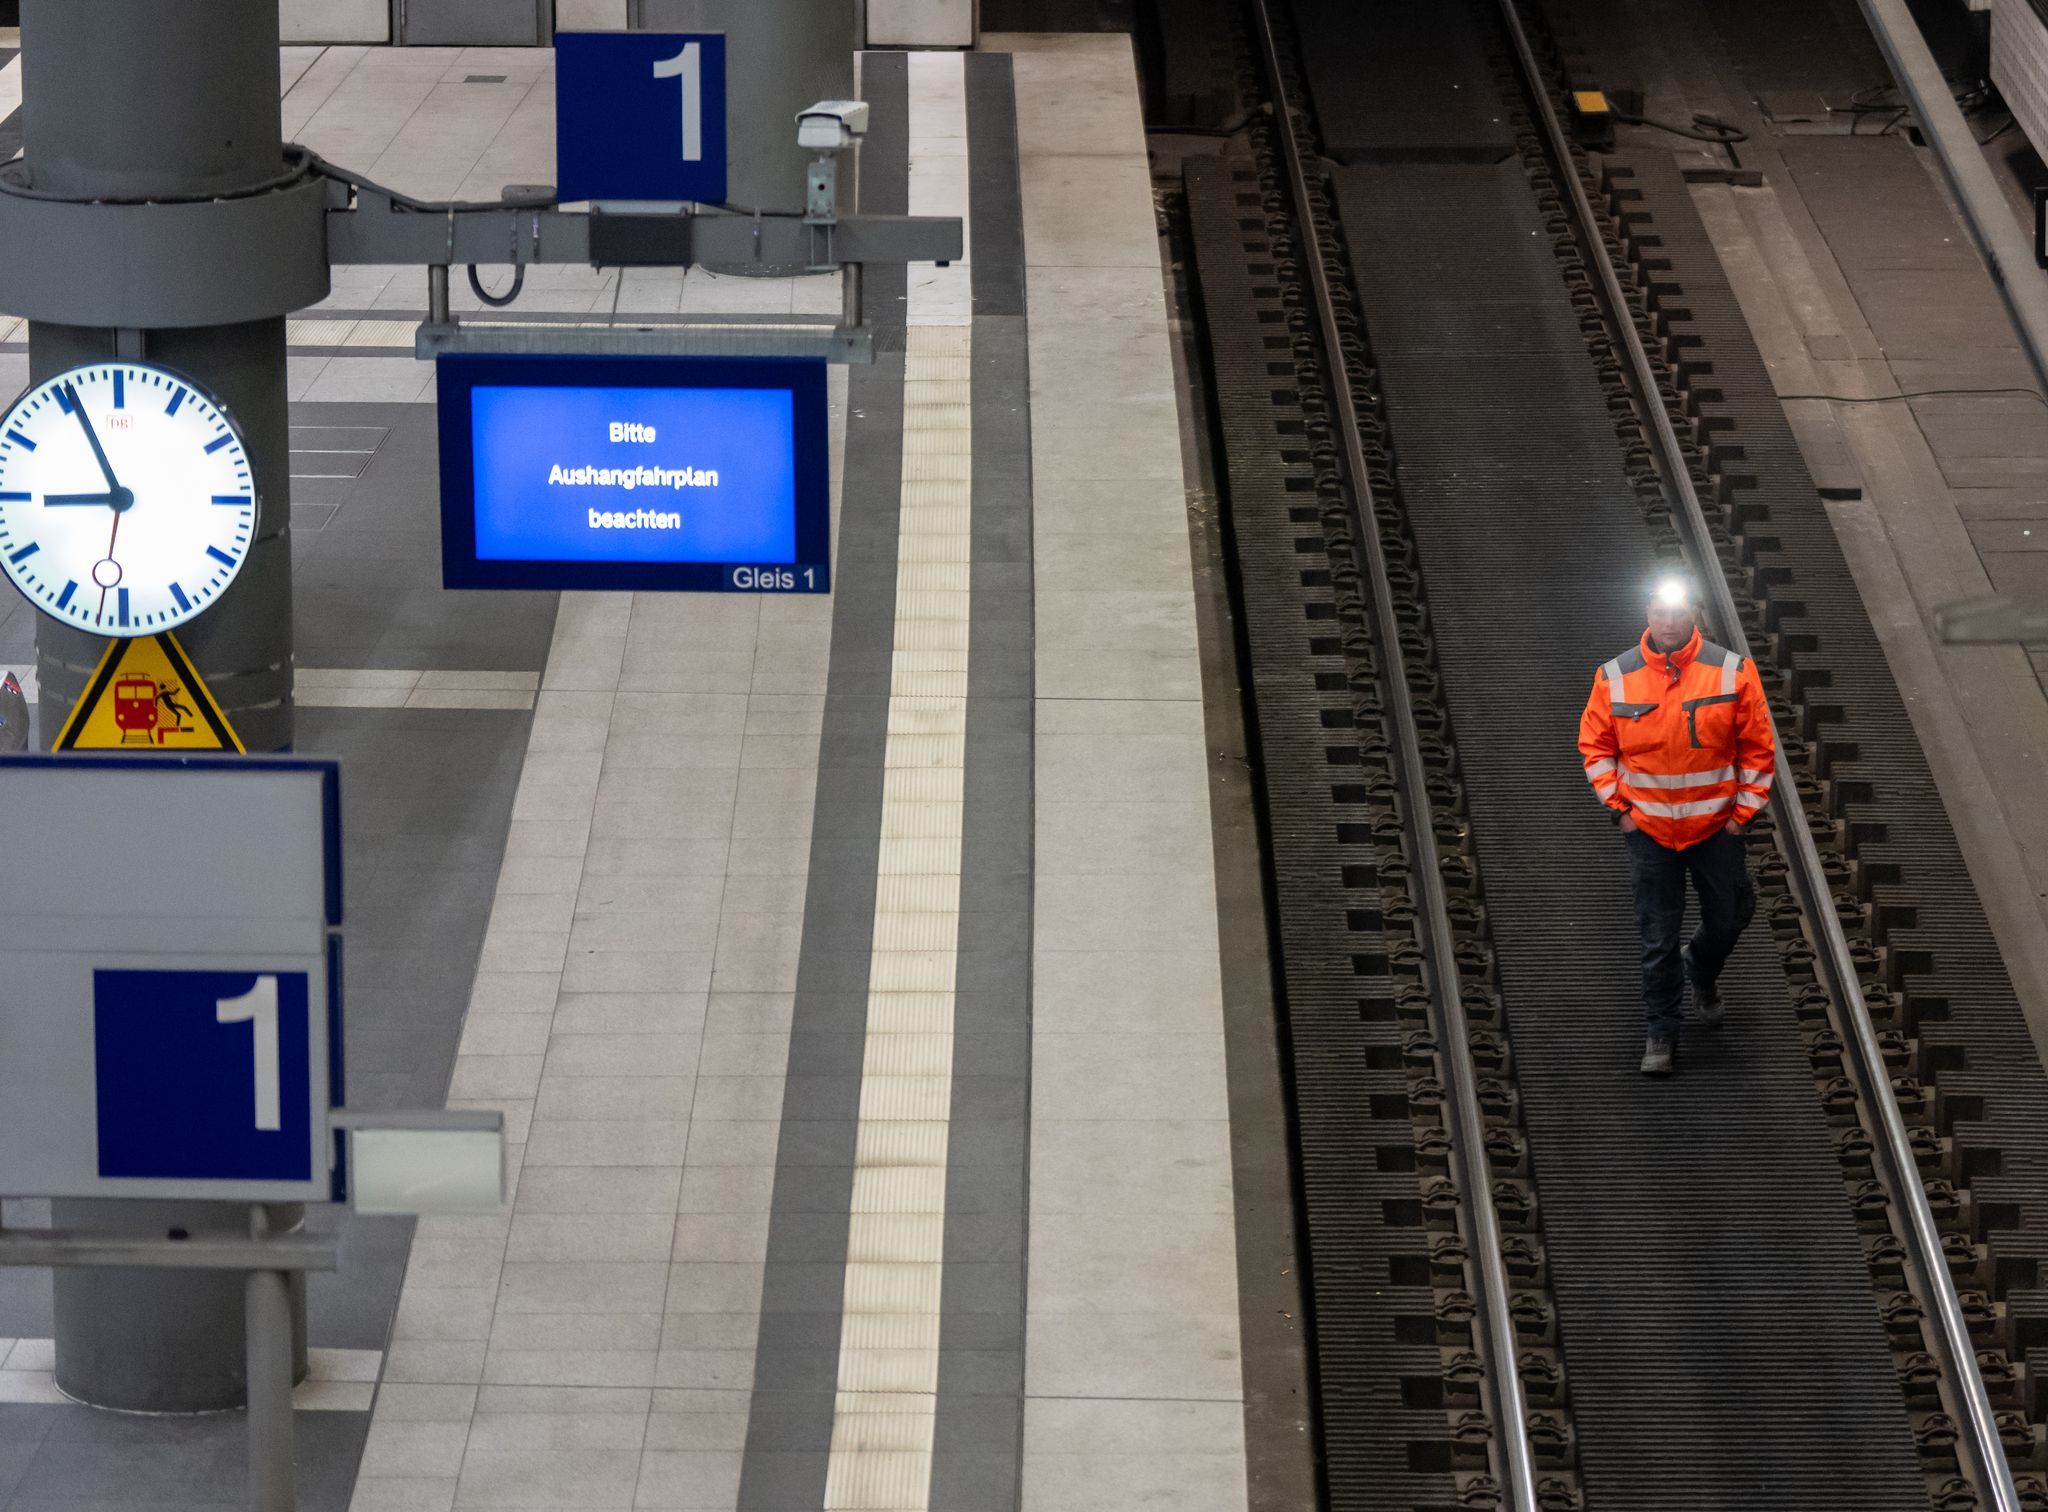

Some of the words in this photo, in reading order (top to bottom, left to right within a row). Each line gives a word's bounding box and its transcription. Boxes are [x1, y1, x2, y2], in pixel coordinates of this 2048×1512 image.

[653, 42, 702, 161] 1
[110, 418, 129, 429] DB
[609, 422, 656, 443] Bitte
[548, 465, 718, 489] Aushangfahrplan
[588, 508, 681, 530] beachten
[733, 567, 795, 589] Gleis
[803, 568, 815, 590] 1
[216, 976, 281, 1130] 1
